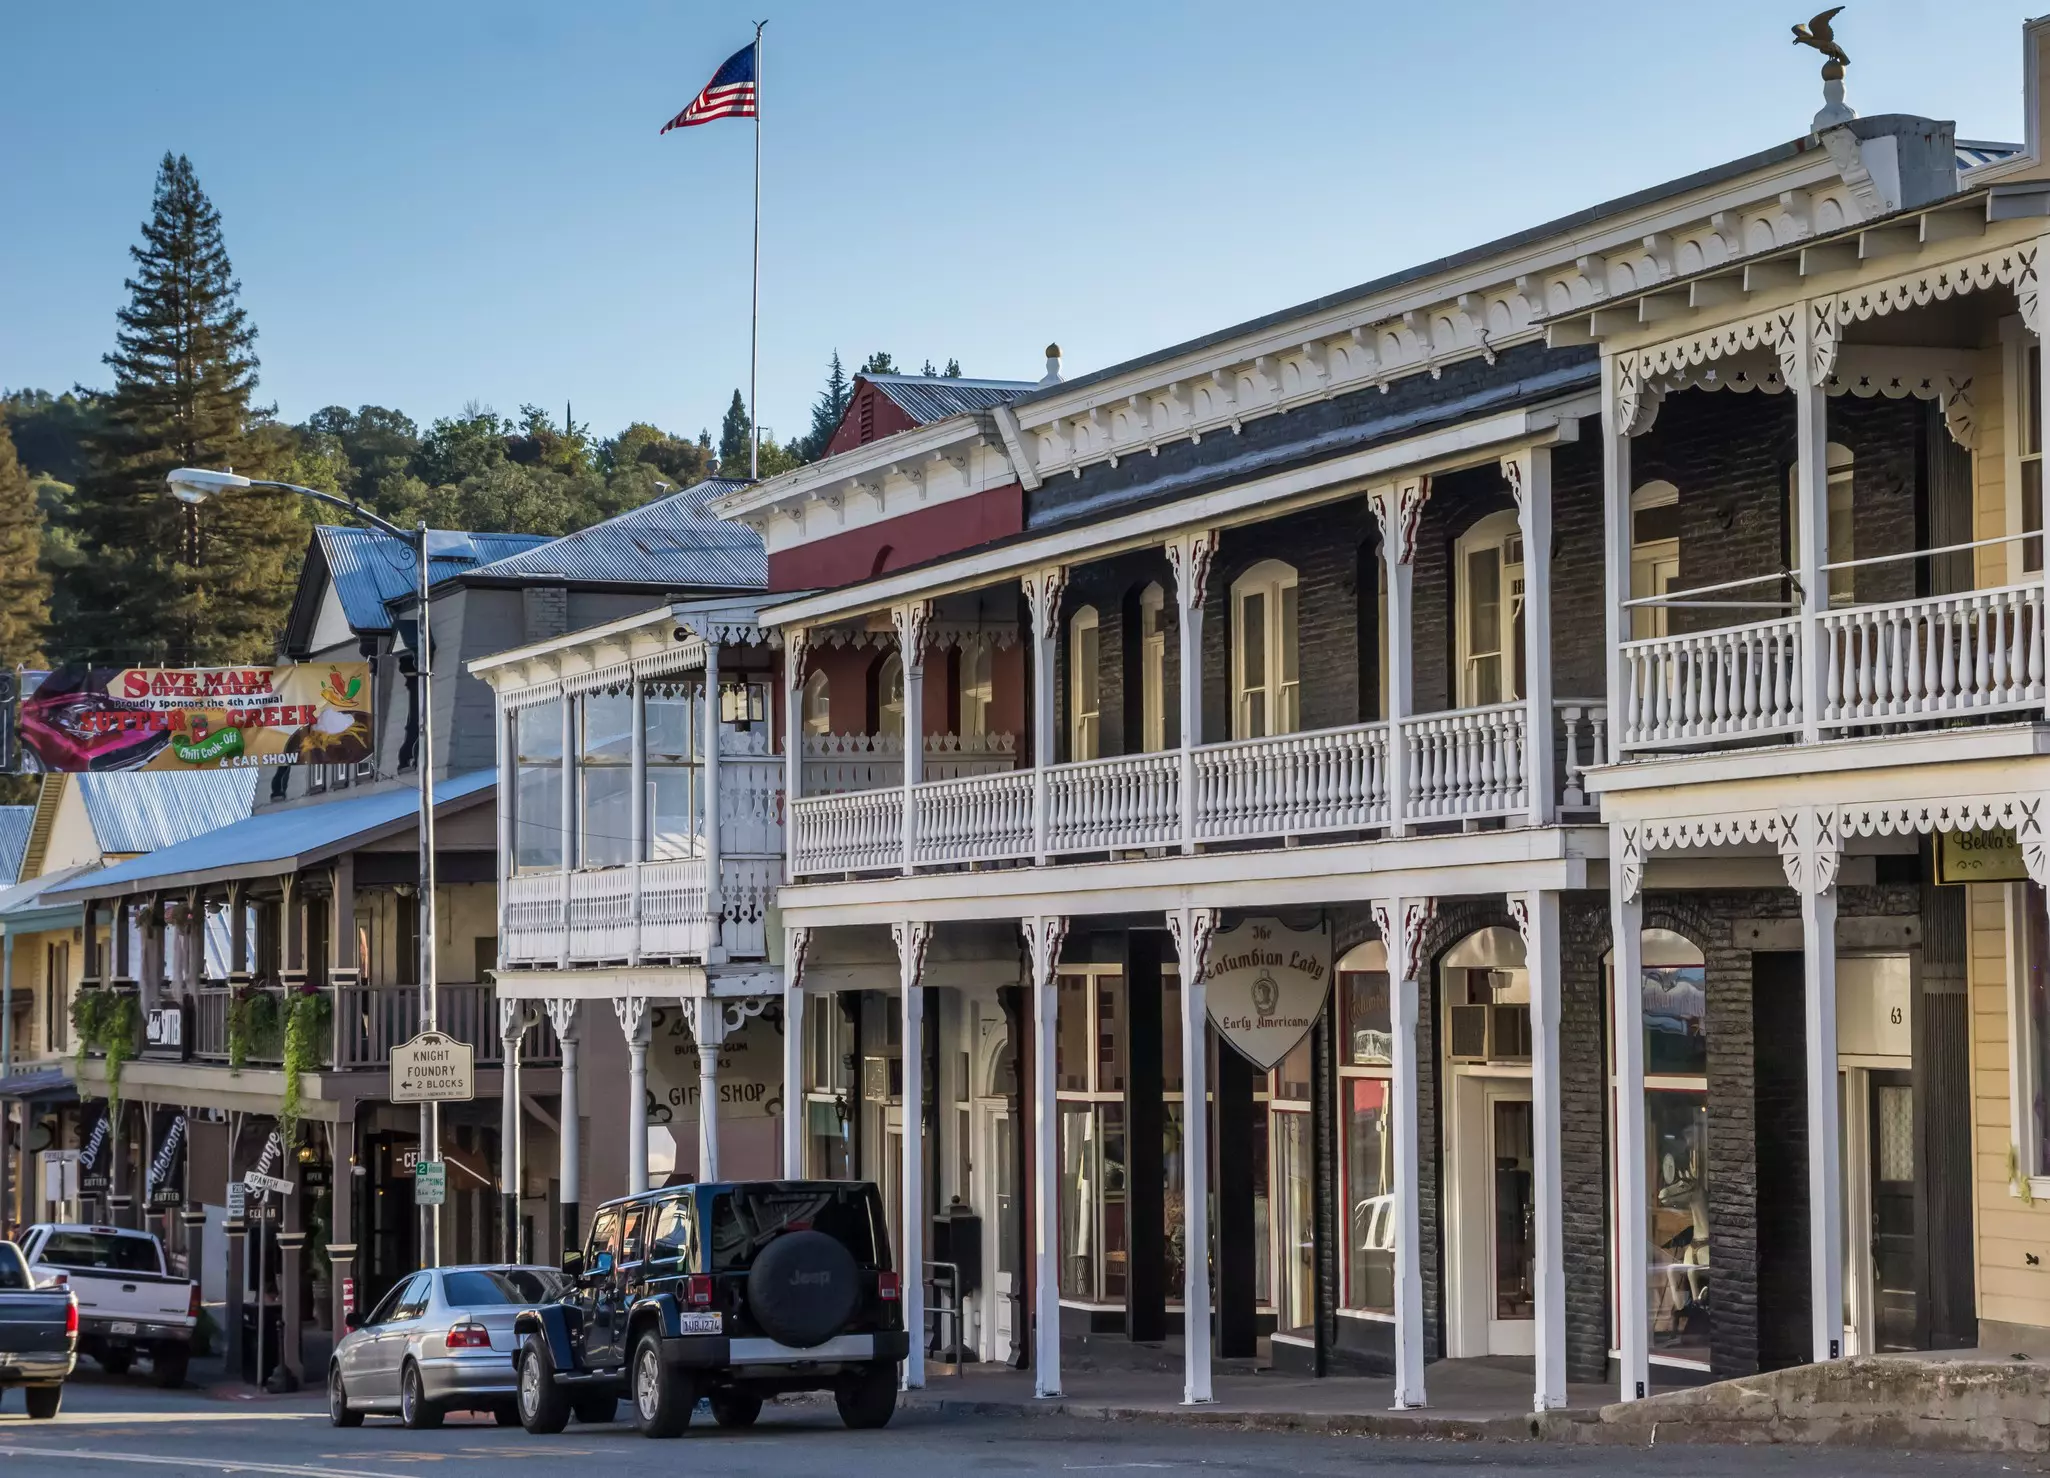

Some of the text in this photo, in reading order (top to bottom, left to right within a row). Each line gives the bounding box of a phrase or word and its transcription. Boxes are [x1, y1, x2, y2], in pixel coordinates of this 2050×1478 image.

[203, 671, 274, 686] MART
[114, 695, 283, 708] Proudly Sponsors the 4th Annual
[80, 704, 318, 732] SUTTER CREEK
[179, 731, 237, 760] Chili Cook-Off
[219, 752, 298, 767] & CAR SHOW
[1953, 830, 2014, 850] Bella's
[1252, 925, 1272, 940] The
[1289, 950, 1325, 980] Lady
[1891, 1006, 1902, 1024] 63
[1223, 1016, 1309, 1031] Early Americana
[724, 1042, 748, 1052] GUM
[413, 1050, 450, 1061] KNIGHT
[407, 1065, 455, 1077] FOUNDRY
[416, 1079, 464, 1089] 2 BLOCKS
[720, 1083, 766, 1102] SHOP
[79, 1117, 110, 1169] Dining
[150, 1115, 186, 1183] Welcome
[250, 1174, 279, 1188] SPANISH
[154, 1192, 179, 1201] SUTTER
[789, 1269, 831, 1288] Jeep
